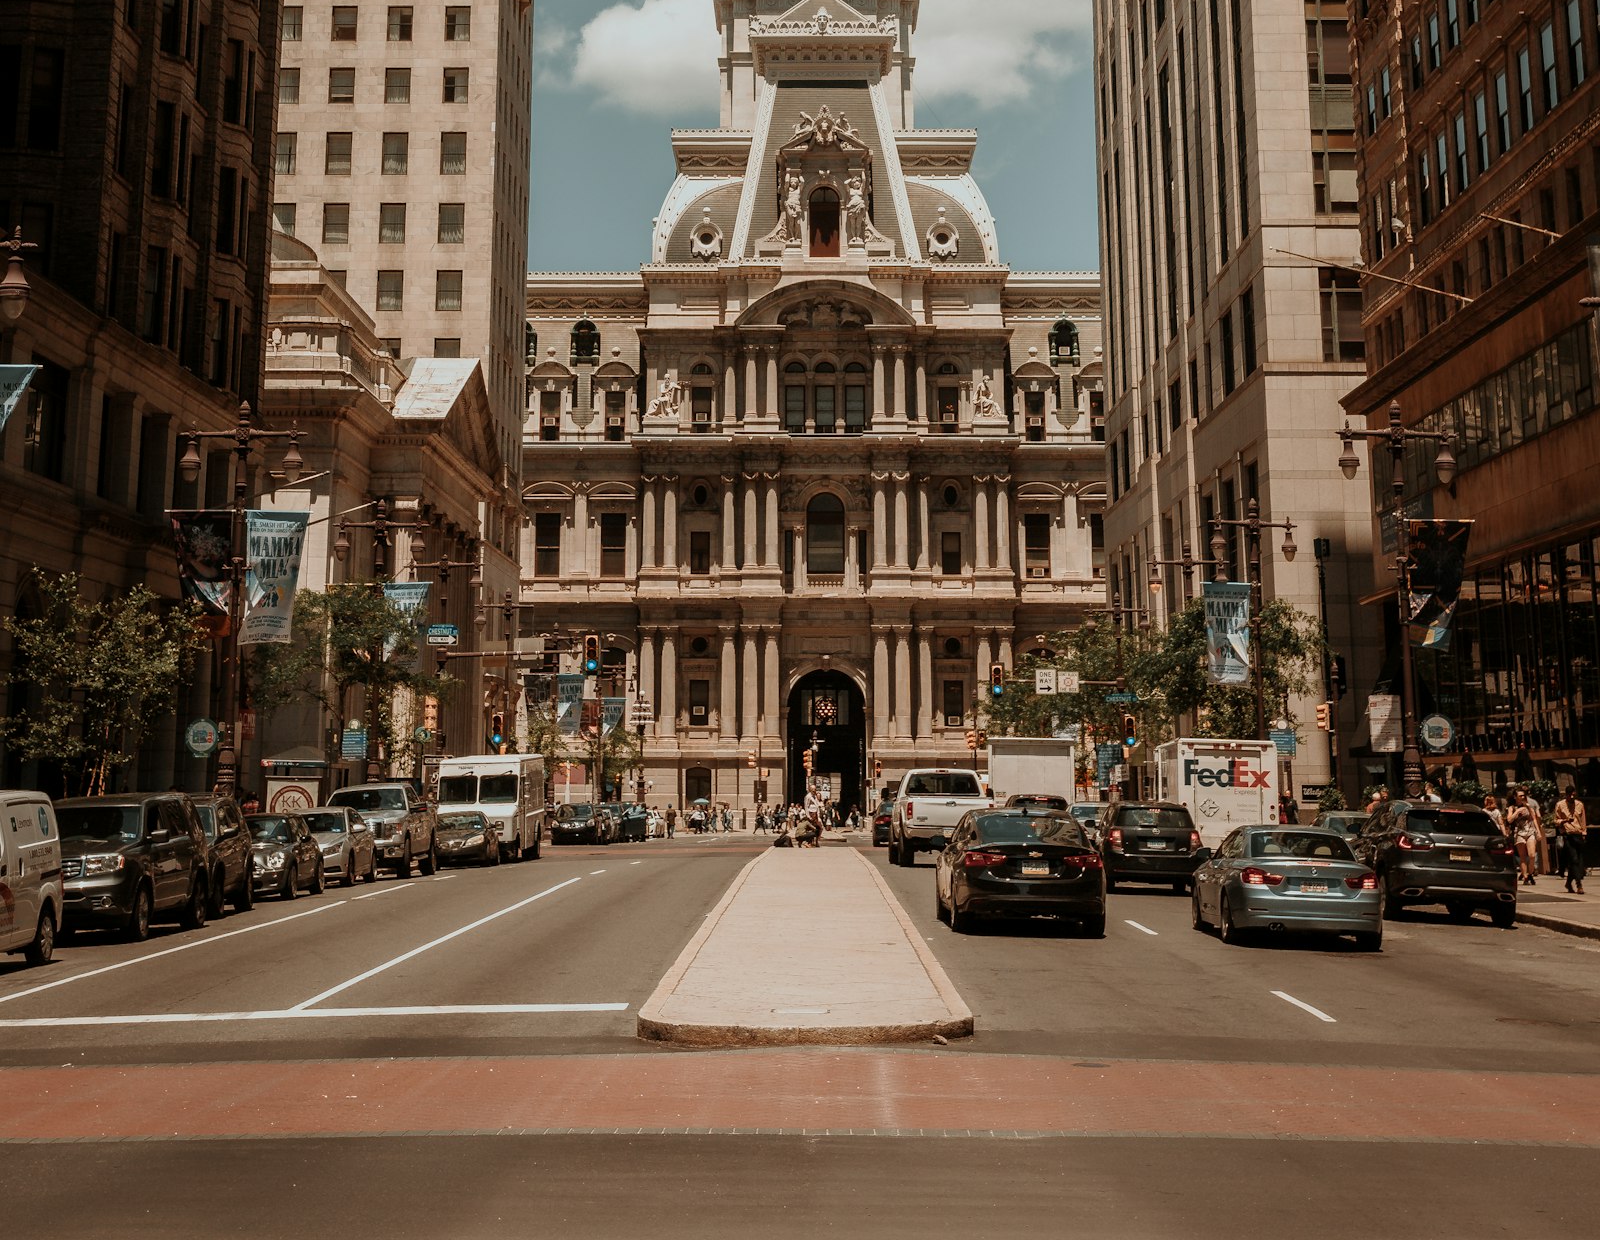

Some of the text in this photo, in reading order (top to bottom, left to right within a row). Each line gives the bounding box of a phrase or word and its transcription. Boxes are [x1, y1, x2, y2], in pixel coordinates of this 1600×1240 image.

[249, 535, 301, 558] MAMMA
[259, 557, 290, 579] MIA!
[1206, 601, 1246, 617] MAMMA
[1183, 759, 1271, 788] FedEx
